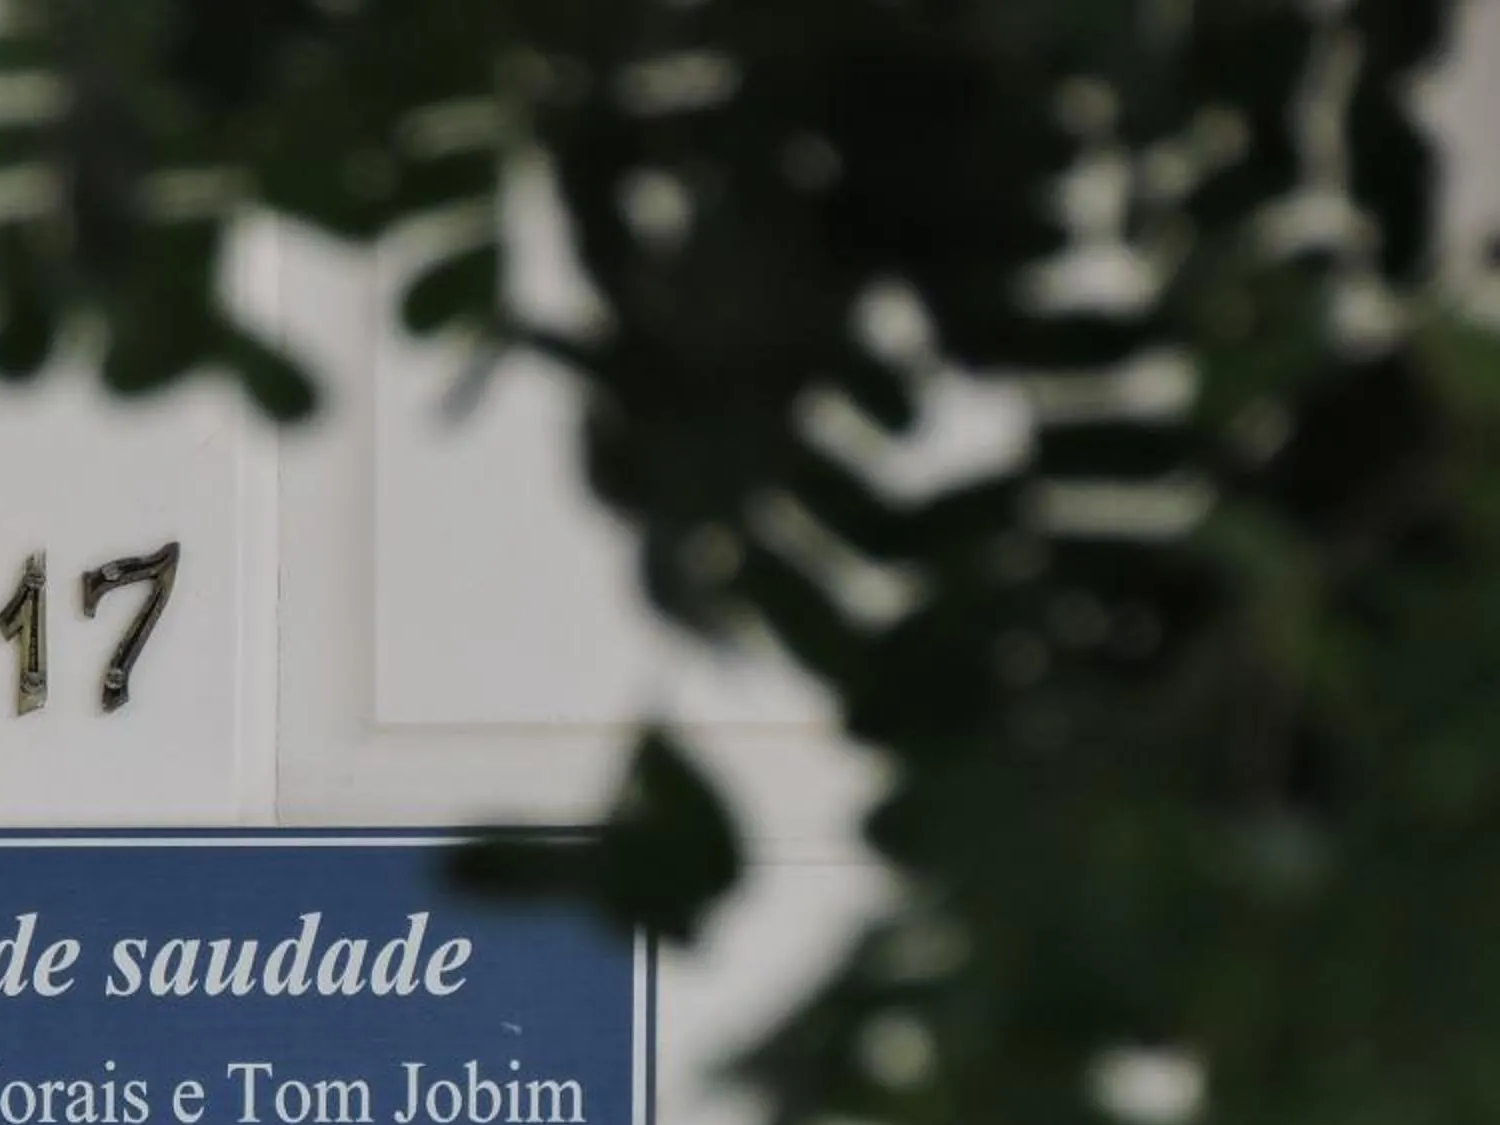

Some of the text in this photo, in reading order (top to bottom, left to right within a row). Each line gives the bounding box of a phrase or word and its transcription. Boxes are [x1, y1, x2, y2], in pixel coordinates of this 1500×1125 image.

[104, 910, 473, 997] saudade
[172, 1080, 205, 1125] e
[226, 1062, 374, 1125] Tom
[393, 1059, 586, 1125] Jobim
